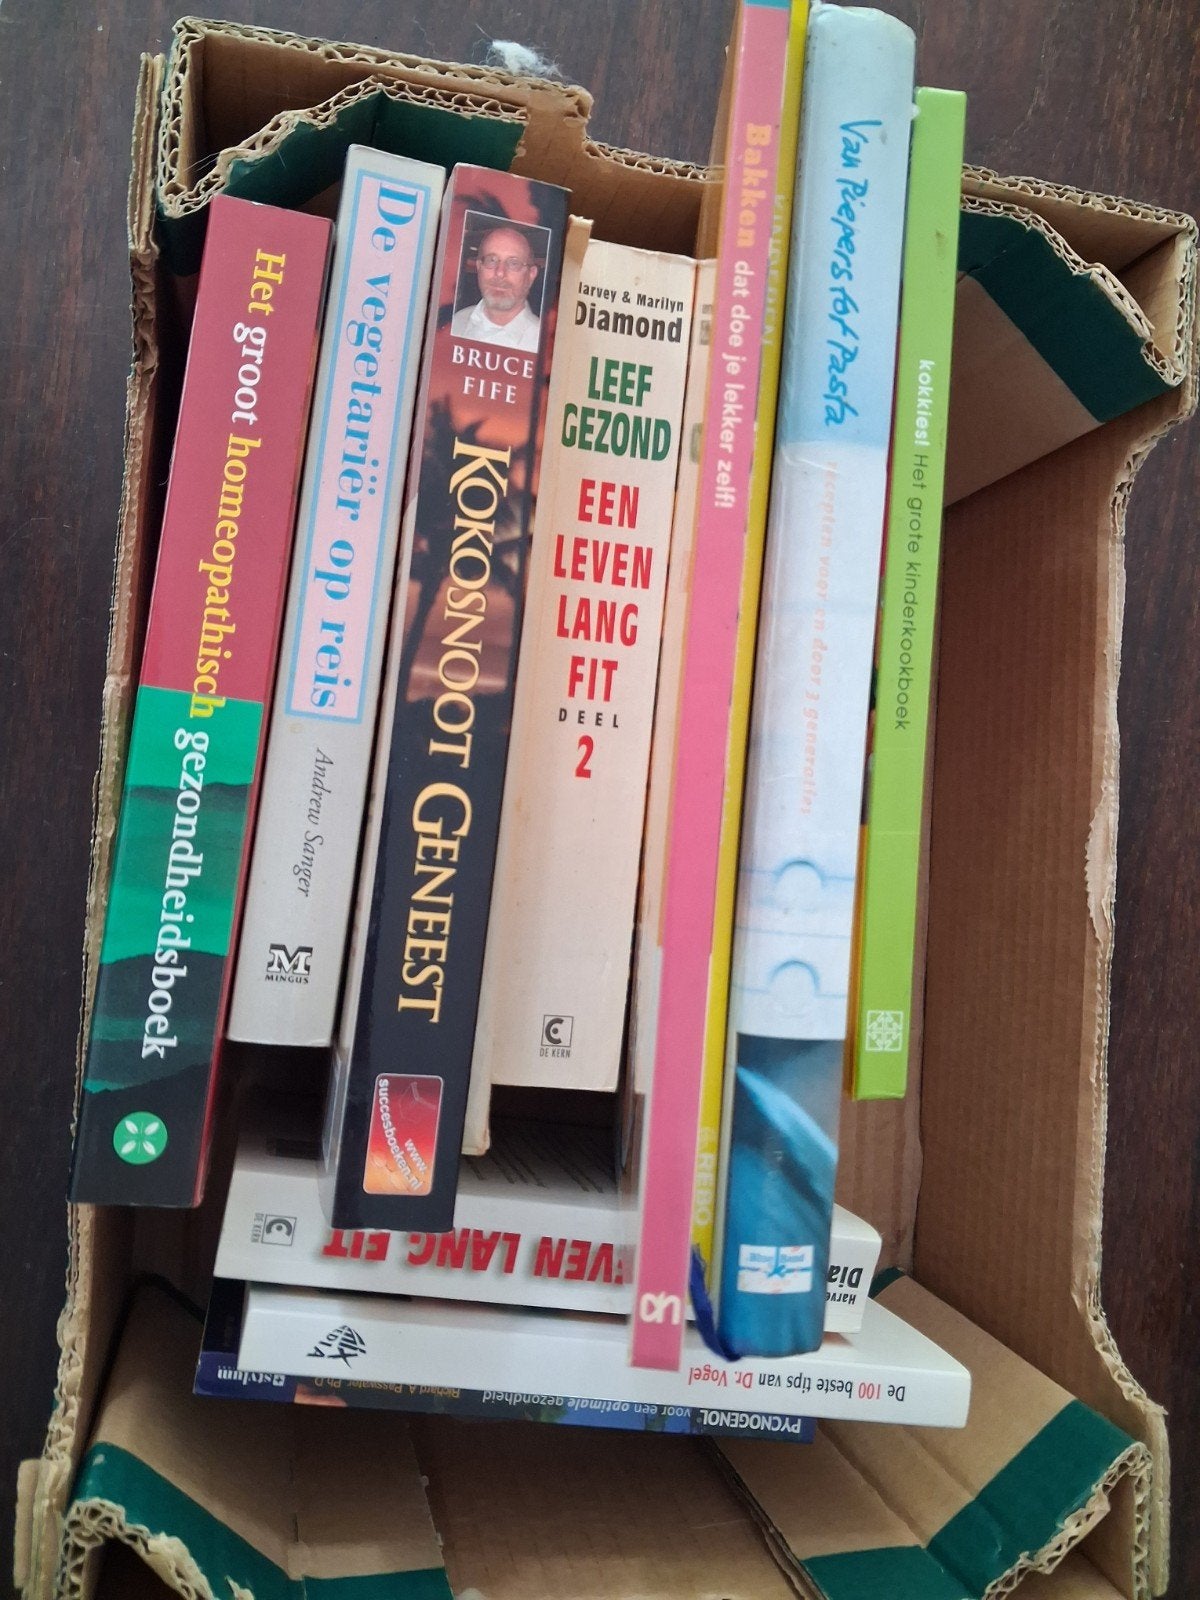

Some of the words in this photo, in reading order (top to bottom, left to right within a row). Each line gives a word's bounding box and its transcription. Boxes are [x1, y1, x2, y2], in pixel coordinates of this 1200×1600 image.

[839, 119, 883, 169] Van
[736, 123, 772, 248] Bakken
[369, 181, 418, 252] De
[830, 179, 869, 281] Piepers
[248, 248, 286, 316] Het
[621, 290, 631, 304] &
[637, 293, 684, 313] Marilyn
[732, 260, 754, 298] dat
[574, 300, 683, 343] Diamond
[729, 304, 751, 347] doe
[231, 321, 267, 426] groot
[451, 344, 535, 379] BRUCE
[587, 356, 653, 407] LEEF
[722, 352, 746, 375] je
[823, 340, 859, 427] Pasta
[336, 272, 394, 521] vegetariër
[462, 375, 517, 404] FIFE
[914, 358, 936, 447] kokkies!
[560, 402, 672, 462] GEZOND
[718, 383, 745, 453] lekker
[714, 460, 736, 509] zelf!
[912, 453, 930, 491] Het
[577, 478, 640, 529] EEN
[906, 497, 924, 554] grote
[190, 433, 261, 719] homeopathisch
[313, 540, 356, 601] op
[553, 534, 653, 590] LEVEN
[428, 436, 512, 769] KOKOSNOOT
[556, 594, 640, 647] LANG
[310, 618, 352, 708] reis
[894, 562, 923, 731] kinderkookboek
[567, 655, 619, 702] FIT
[558, 707, 619, 729] DEEL
[575, 734, 595, 779] 2
[308, 747, 334, 826] Andrew
[292, 830, 324, 898] Sanger
[141, 728, 210, 1060] gezondheidsboek
[397, 782, 473, 1023] GENEEST
[264, 974, 309, 984] MINGUS
[539, 1048, 550, 1058] DE
[551, 1048, 571, 1059] KERN
[534, 1236, 623, 1285] VEN
[688, 1364, 728, 1386] Vogel
[734, 1370, 754, 1389] Dr.
[758, 1373, 781, 1388] van
[786, 1373, 812, 1395] tips
[816, 1378, 853, 1399] beste
[857, 1382, 881, 1399] 100
[887, 1385, 906, 1402] De
[567, 1397, 629, 1412] optimale
[634, 1403, 658, 1416] een
[662, 1405, 691, 1418] voor
